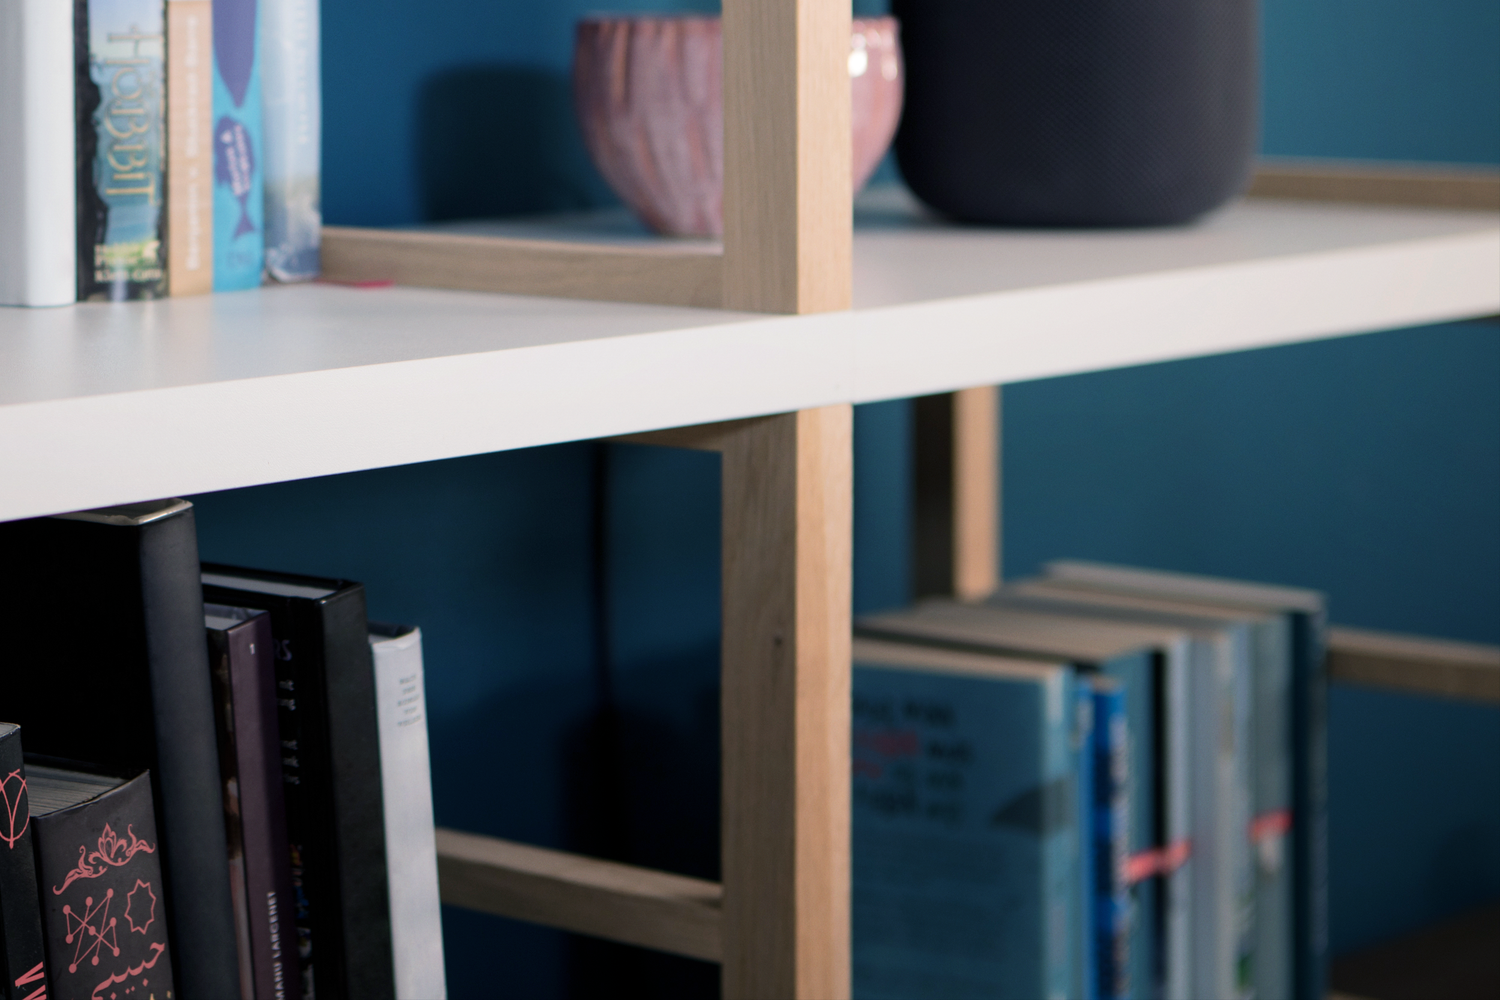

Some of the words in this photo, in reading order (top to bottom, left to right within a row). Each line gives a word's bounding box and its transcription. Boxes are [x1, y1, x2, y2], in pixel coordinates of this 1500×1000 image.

[103, 25, 163, 207] HOBBIT
[266, 891, 282, 959] LARCENET
[272, 961, 286, 1000] MANU
